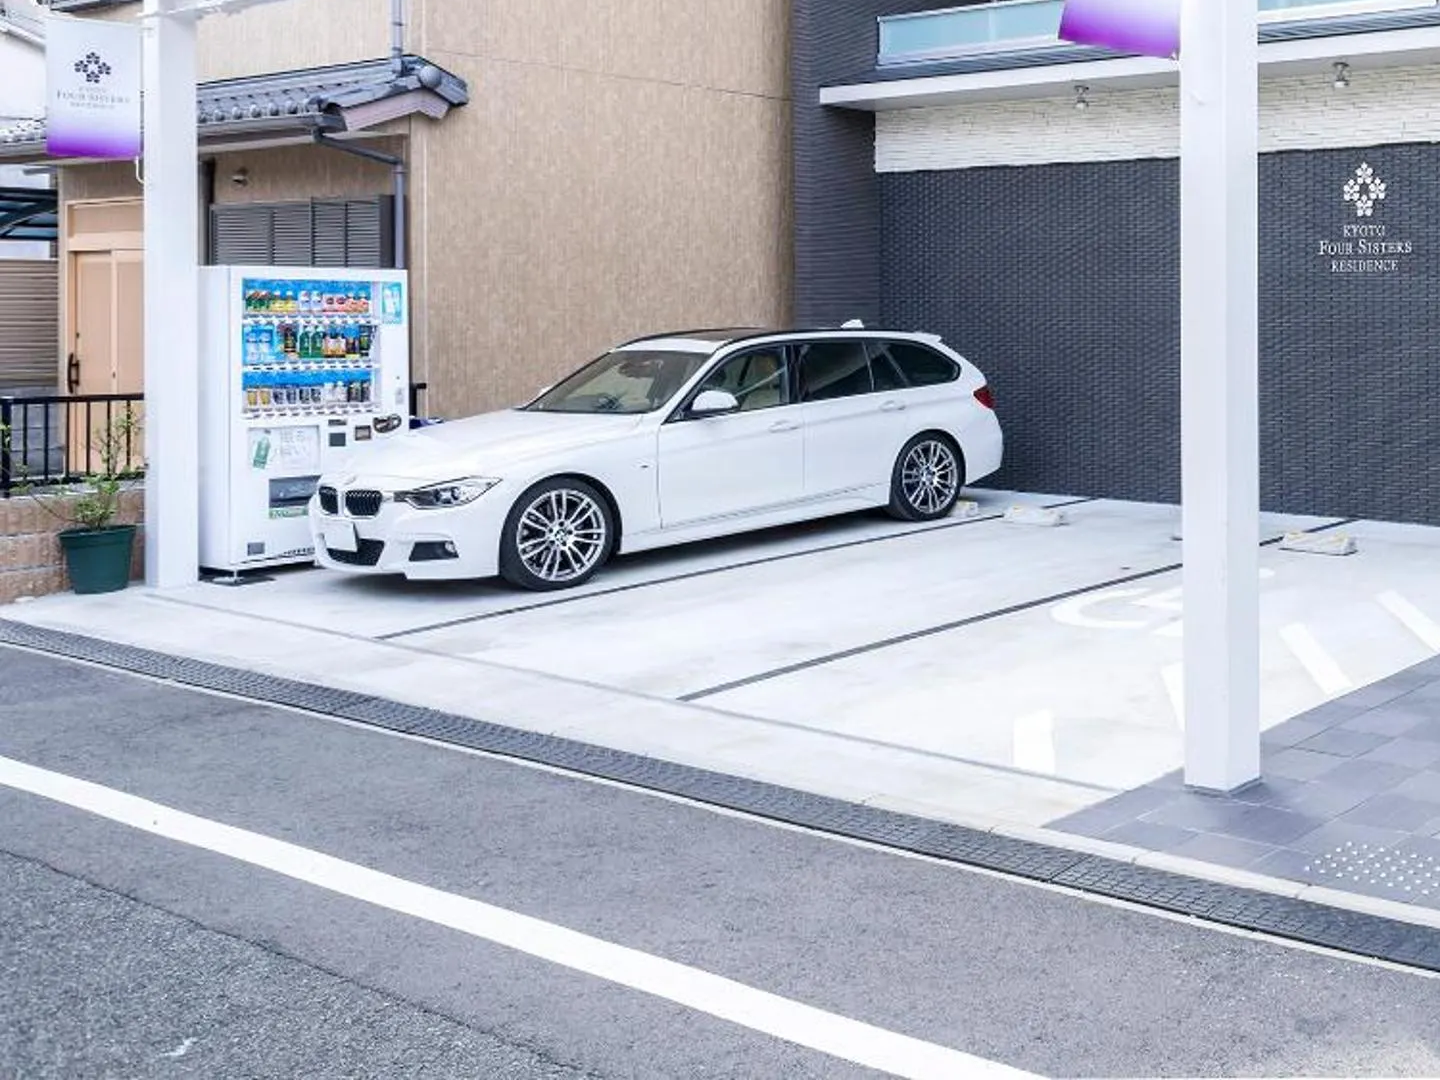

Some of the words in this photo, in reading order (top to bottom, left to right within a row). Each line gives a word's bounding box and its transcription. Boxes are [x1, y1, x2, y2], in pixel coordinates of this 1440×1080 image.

[1343, 224, 1385, 238] KYOTO
[1319, 240, 1353, 255] FOUR
[1358, 238, 1412, 255] SISTERS
[1331, 260, 1398, 272] RESIDENCE
